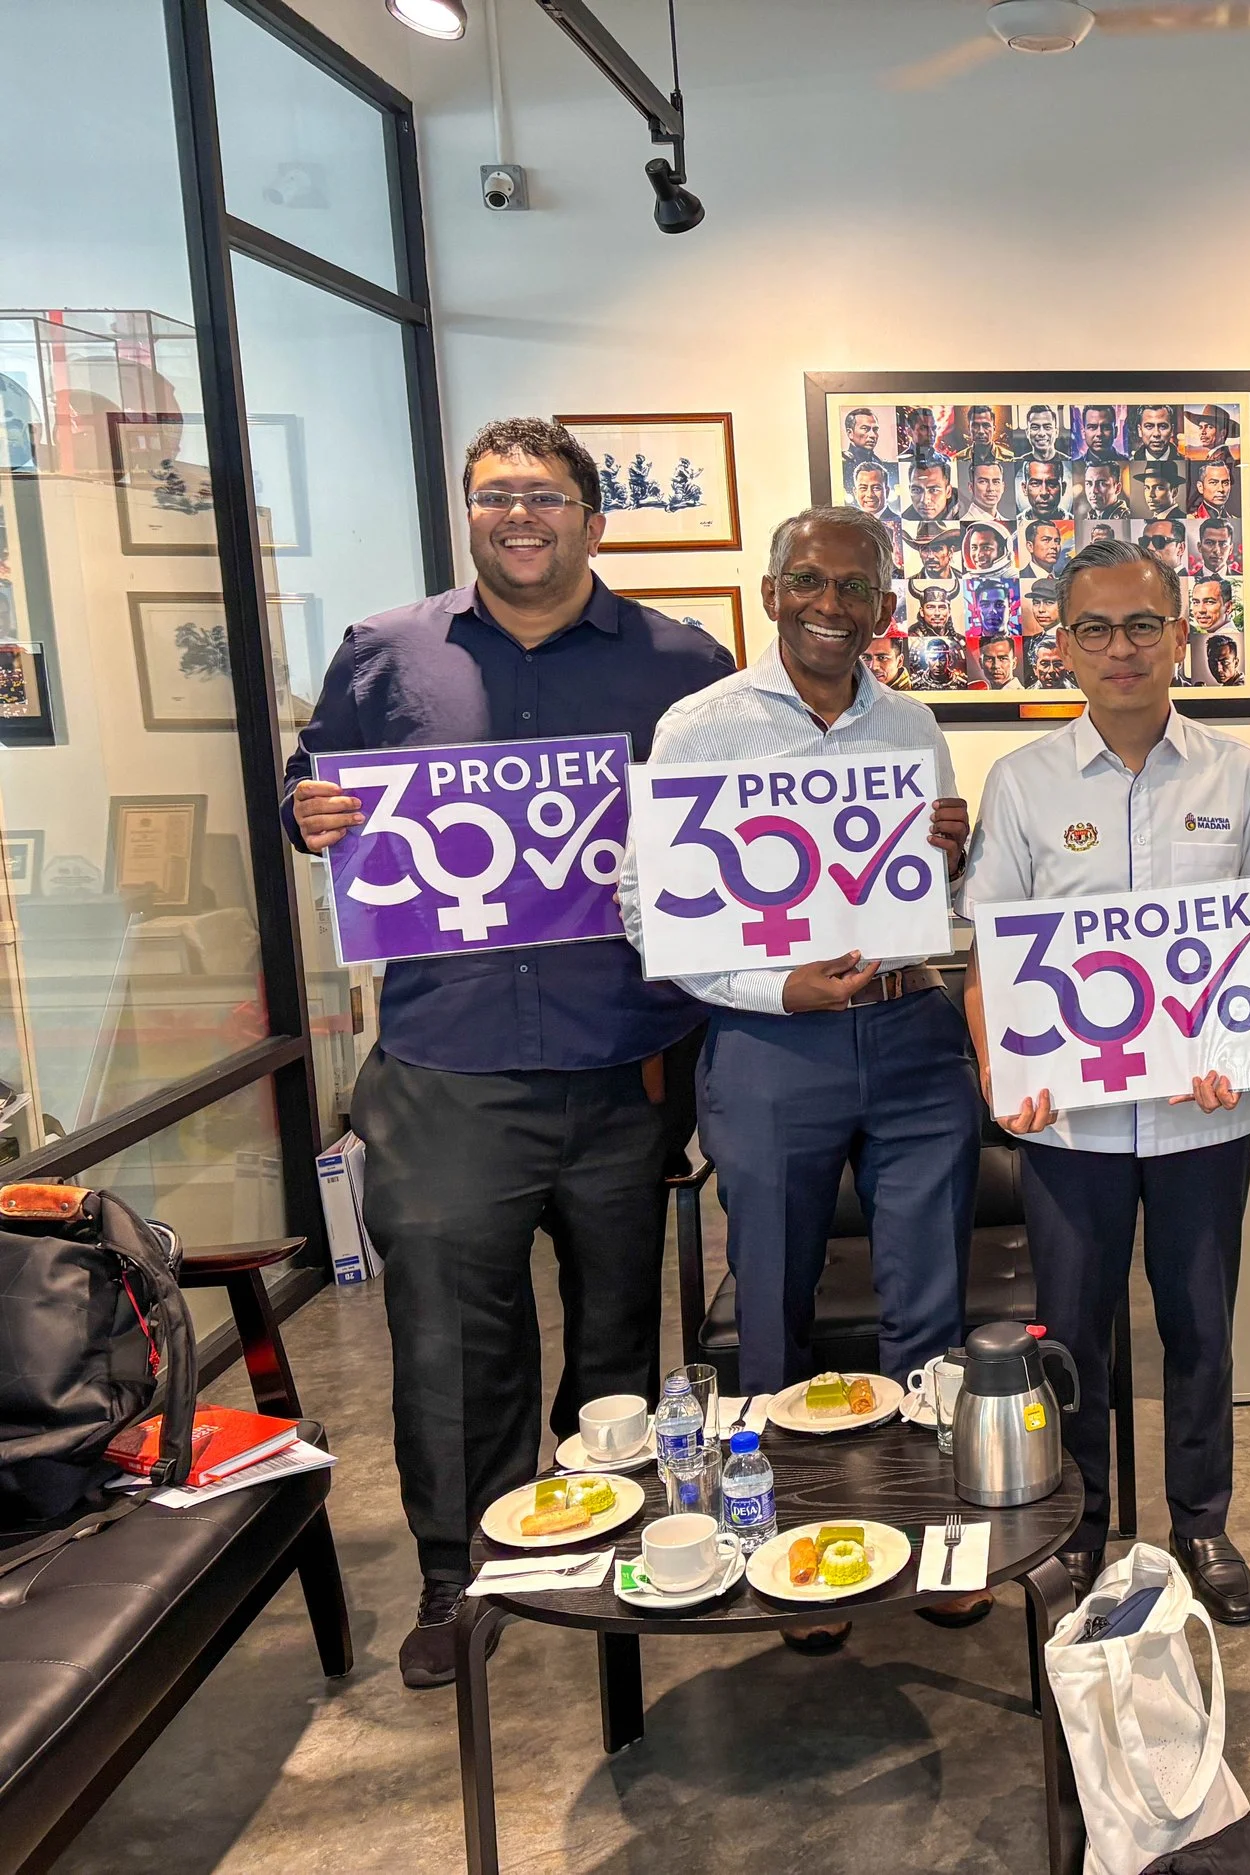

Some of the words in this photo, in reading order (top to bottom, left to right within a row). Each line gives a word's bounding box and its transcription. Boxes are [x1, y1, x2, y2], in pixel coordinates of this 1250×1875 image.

[428, 749, 621, 796] PROJEK
[738, 764, 926, 808] PROJEK
[1197, 816, 1230, 824] MALAYSIA
[1197, 822, 1231, 830] MADANI
[733, 1506, 758, 1517] DESA
